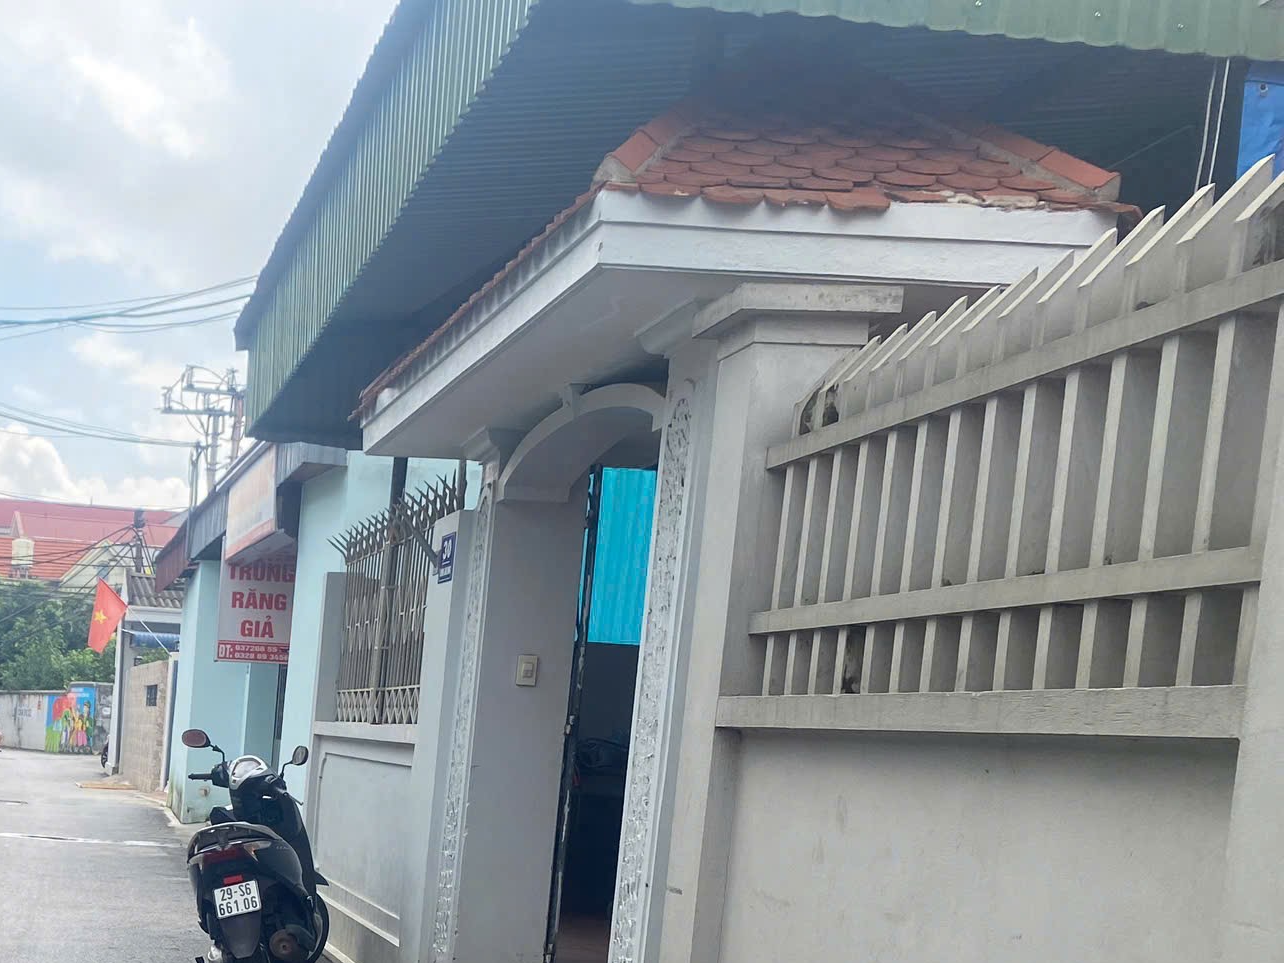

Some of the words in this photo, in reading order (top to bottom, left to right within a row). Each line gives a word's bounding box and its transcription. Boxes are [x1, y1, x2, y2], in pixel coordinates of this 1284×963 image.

[231, 588, 287, 611] RĂNG
[240, 615, 274, 639] GIẢ
[220, 883, 251, 901] 29-S6
[218, 896, 258, 916] 661.06
